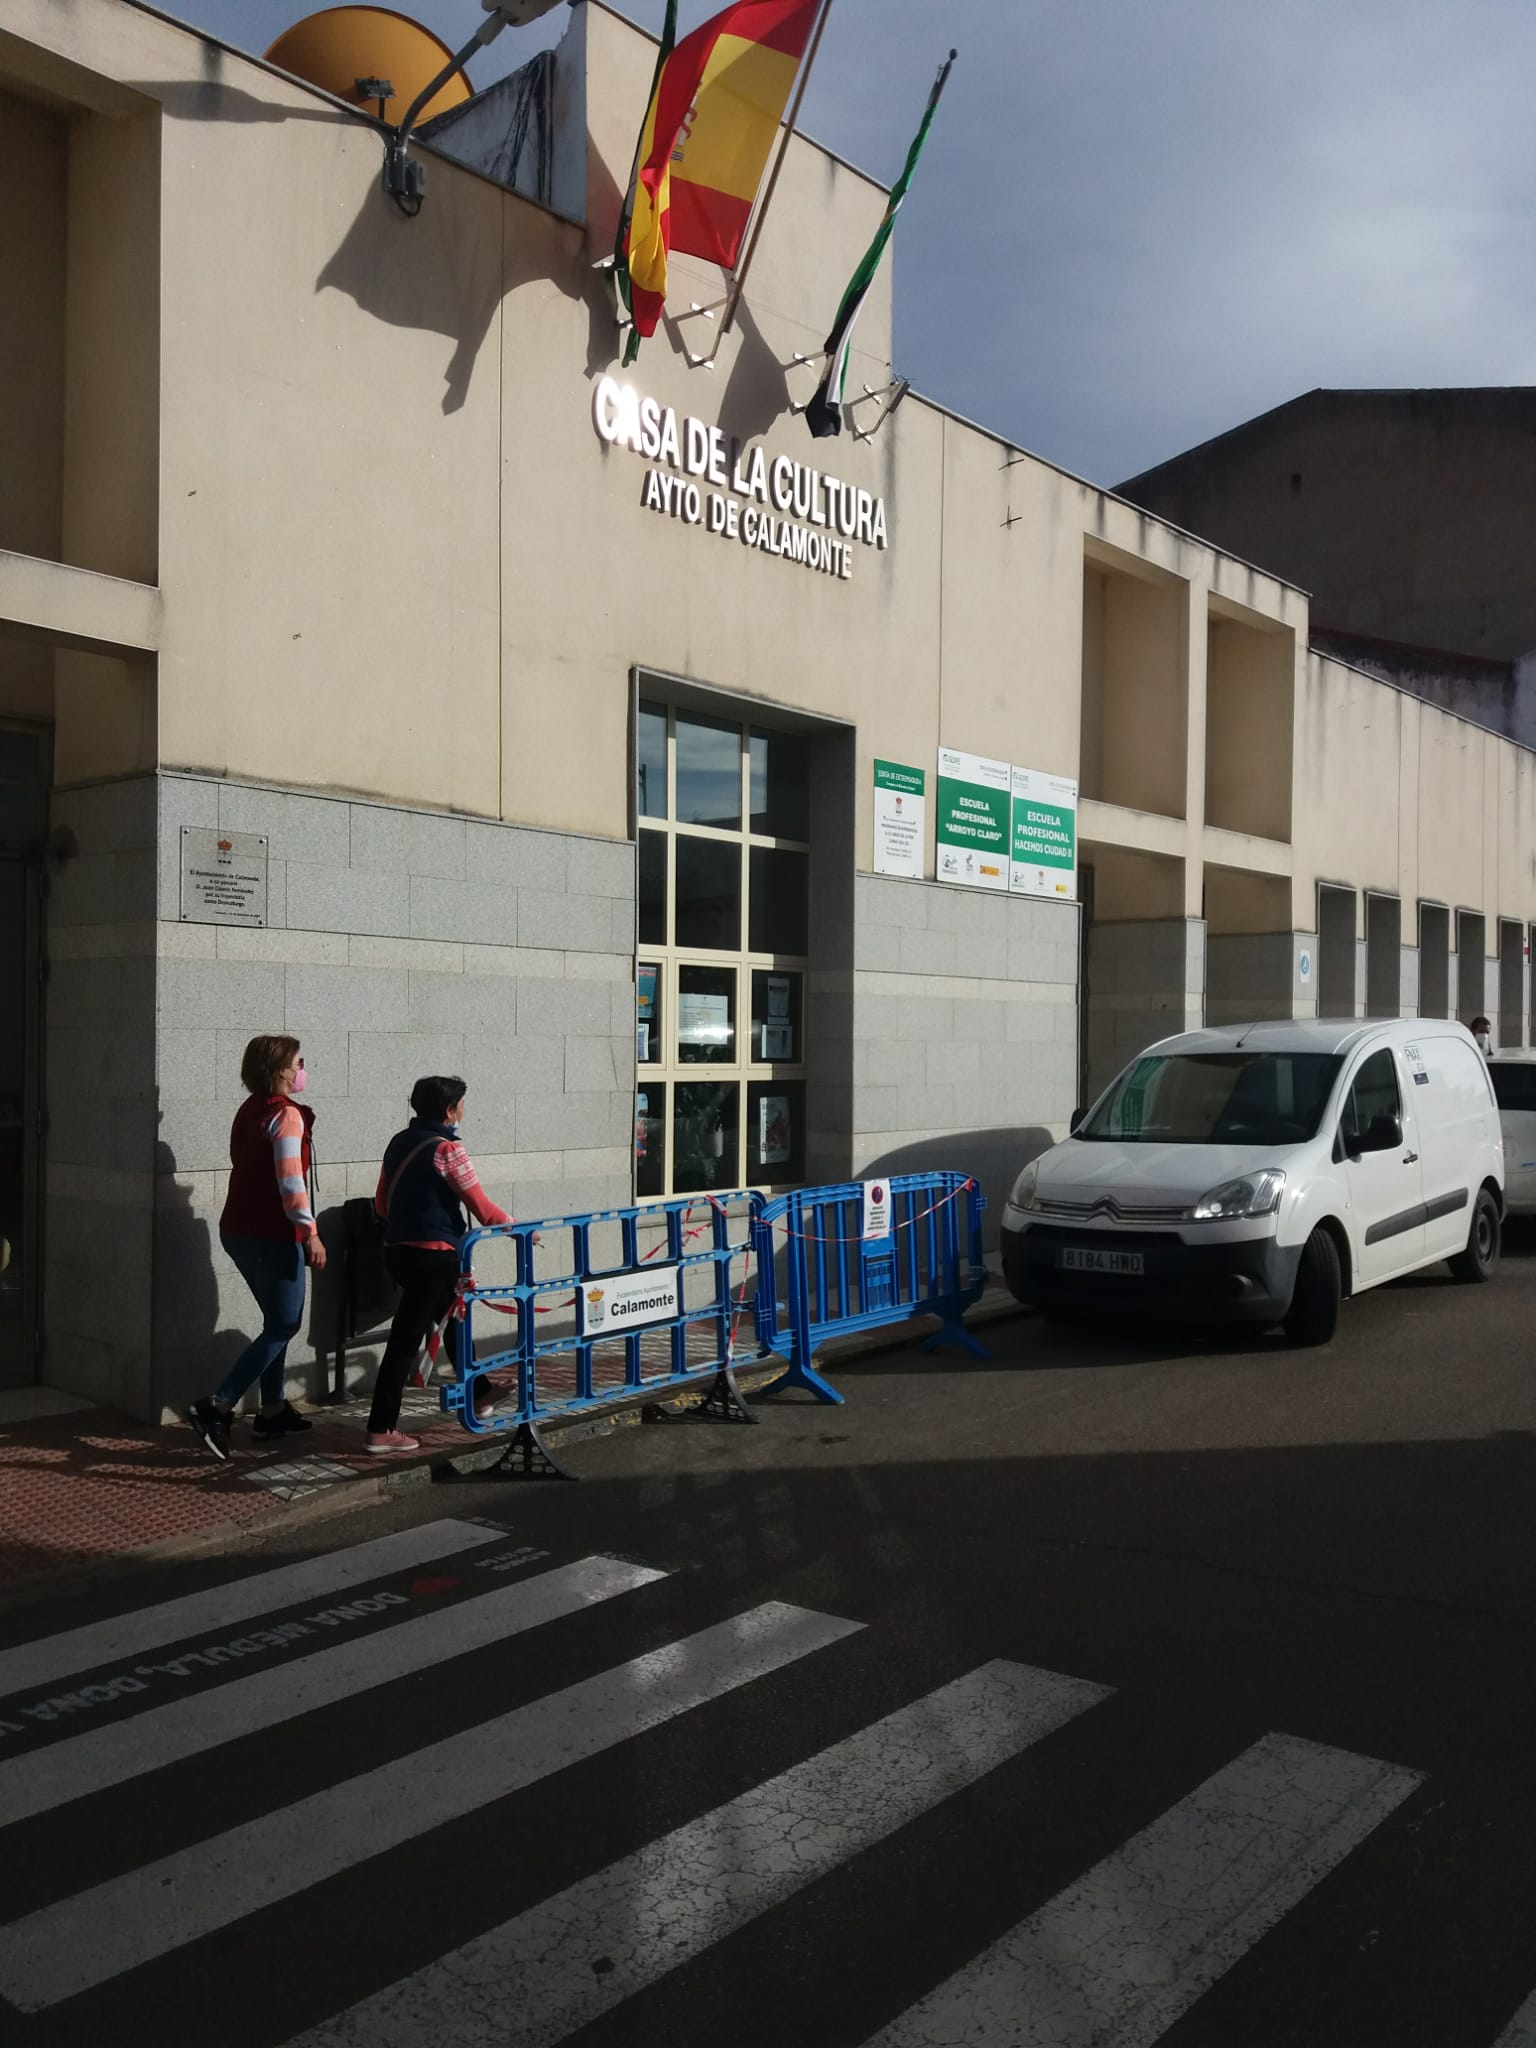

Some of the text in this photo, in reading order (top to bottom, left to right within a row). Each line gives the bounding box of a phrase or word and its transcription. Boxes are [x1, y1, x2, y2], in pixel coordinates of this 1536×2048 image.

[594, 376, 888, 549] CASA DE LA CULTURA
[642, 469, 852, 579] AYTO. DE CALAMONTE
[959, 797, 990, 811] ESCUELA
[951, 810, 997, 827] PROFESIONAL
[1027, 811, 1061, 826] ESCUELA
[1017, 825, 1070, 844] PROFESIONAL
[1015, 839, 1044, 853] HACEMOS
[1044, 844, 1067, 857] CIUDAD
[611, 1293, 674, 1316] Calamonte
[305, 1591, 409, 1627] DONA
